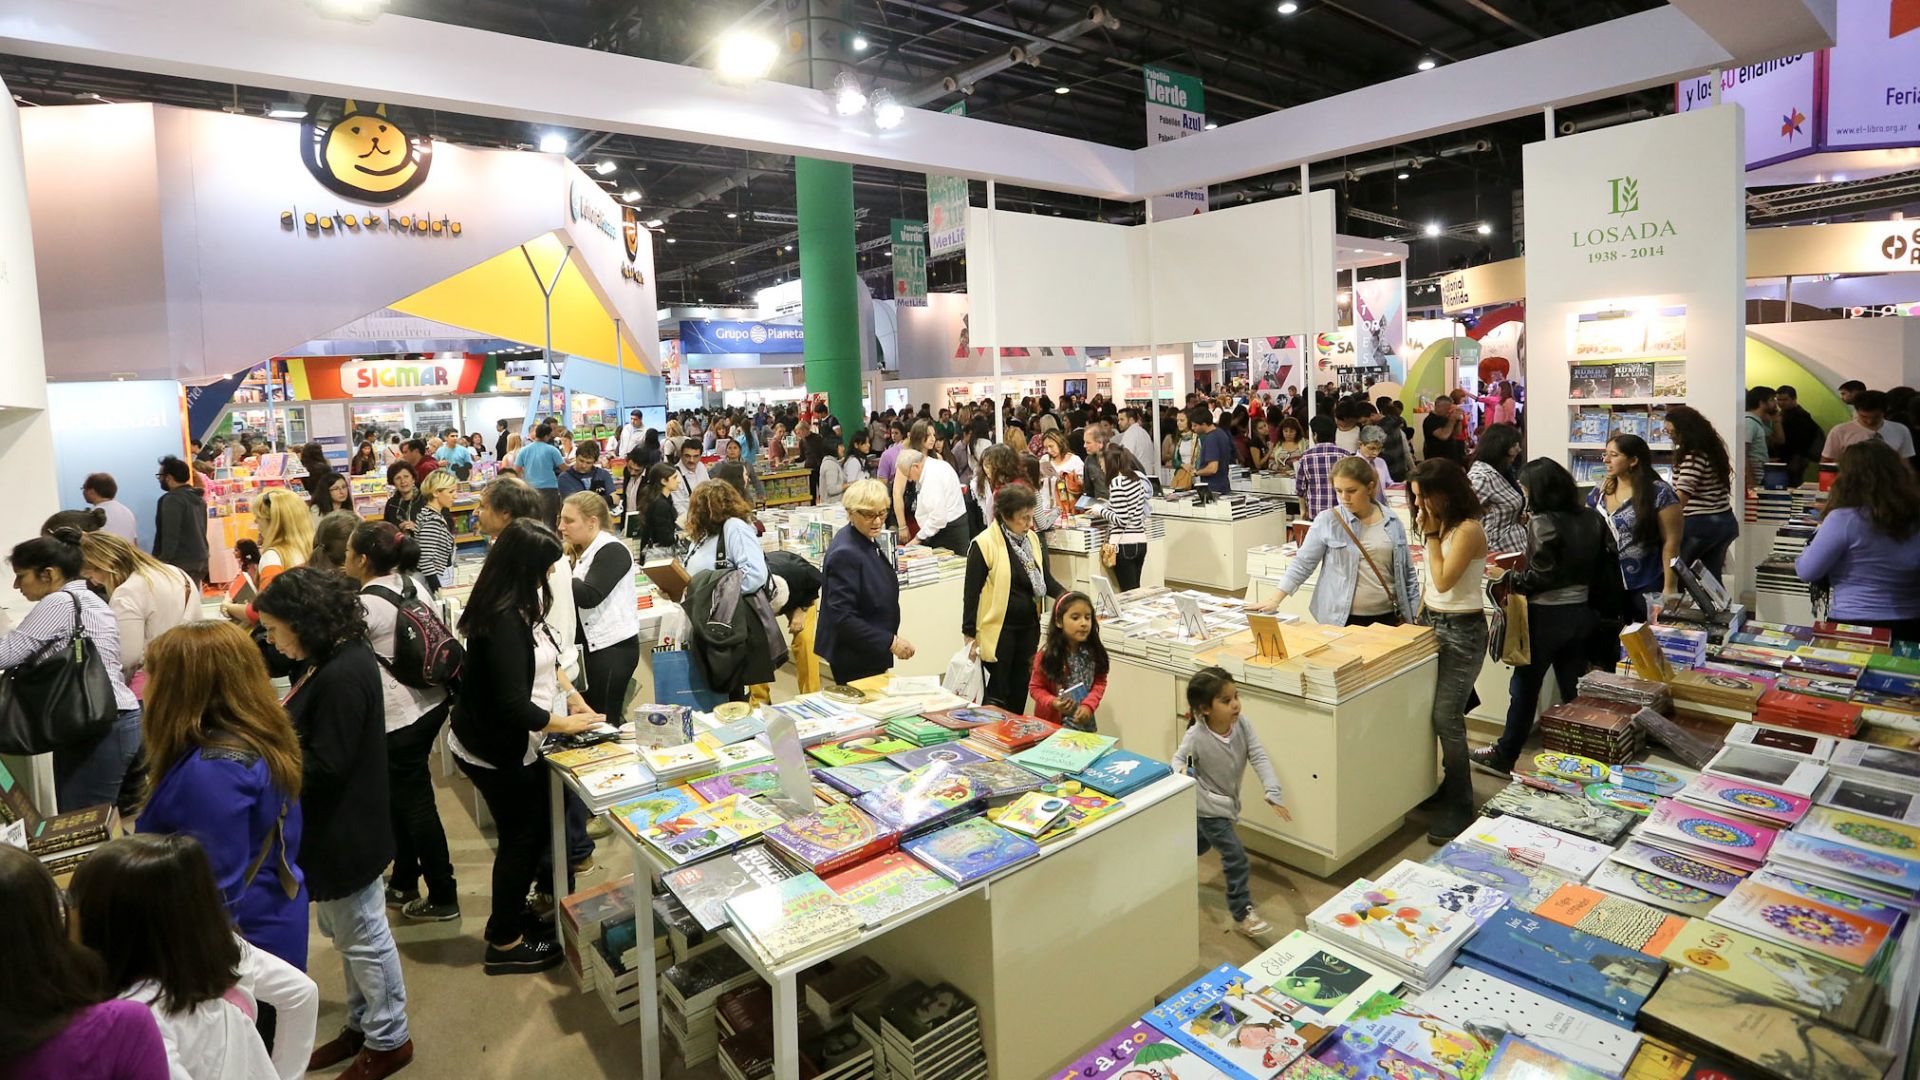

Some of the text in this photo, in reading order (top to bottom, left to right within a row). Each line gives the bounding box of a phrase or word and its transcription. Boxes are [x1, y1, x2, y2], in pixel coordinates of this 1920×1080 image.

[1146, 78, 1188, 108] Verde
[1686, 87, 1694, 112] y
[1696, 79, 1712, 101] los
[1182, 112, 1201, 132] Azul
[1835, 123, 1908, 136] www.el-libro.org.ar
[900, 230, 923, 242] Verde
[932, 227, 966, 250] MetLif
[1571, 218, 1679, 248] LOSADA
[910, 246, 924, 269] 16
[1587, 250, 1619, 264] 1938
[1630, 244, 1665, 260] 2014
[896, 299, 926, 308] MetLife
[715, 327, 804, 342] Grupo Planeta
[1337, 341, 1355, 354] SA
[357, 365, 449, 389] SIGMAR
[742, 848, 786, 881] RUMB
[1260, 949, 1296, 977] Estela
[1152, 980, 1212, 1019] Pintura
[1174, 975, 1243, 1022] Escultura
